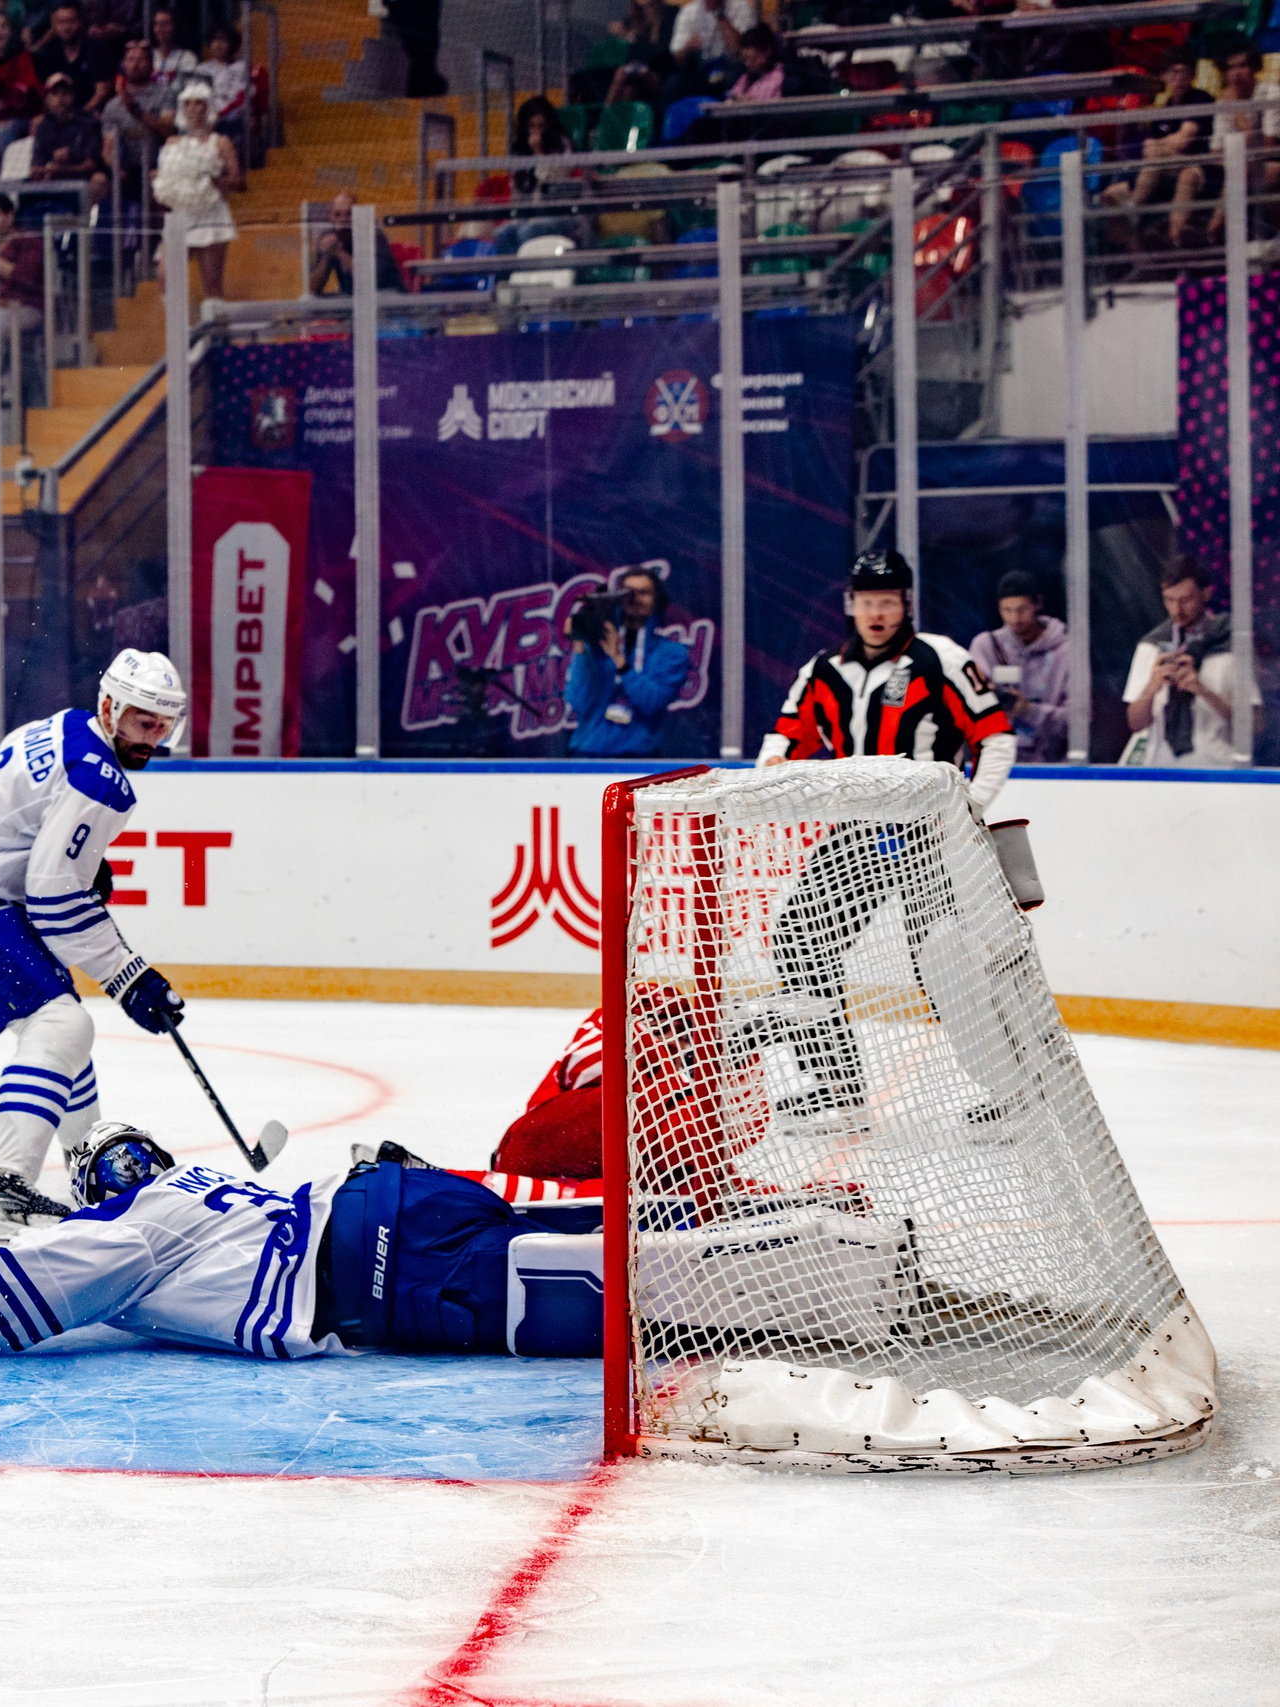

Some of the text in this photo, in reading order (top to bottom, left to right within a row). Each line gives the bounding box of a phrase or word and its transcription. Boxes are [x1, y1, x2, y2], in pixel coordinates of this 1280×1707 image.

[232, 549, 266, 757] IMPBET
[65, 823, 91, 860] 9
[372, 1225, 390, 1300] BAUER
